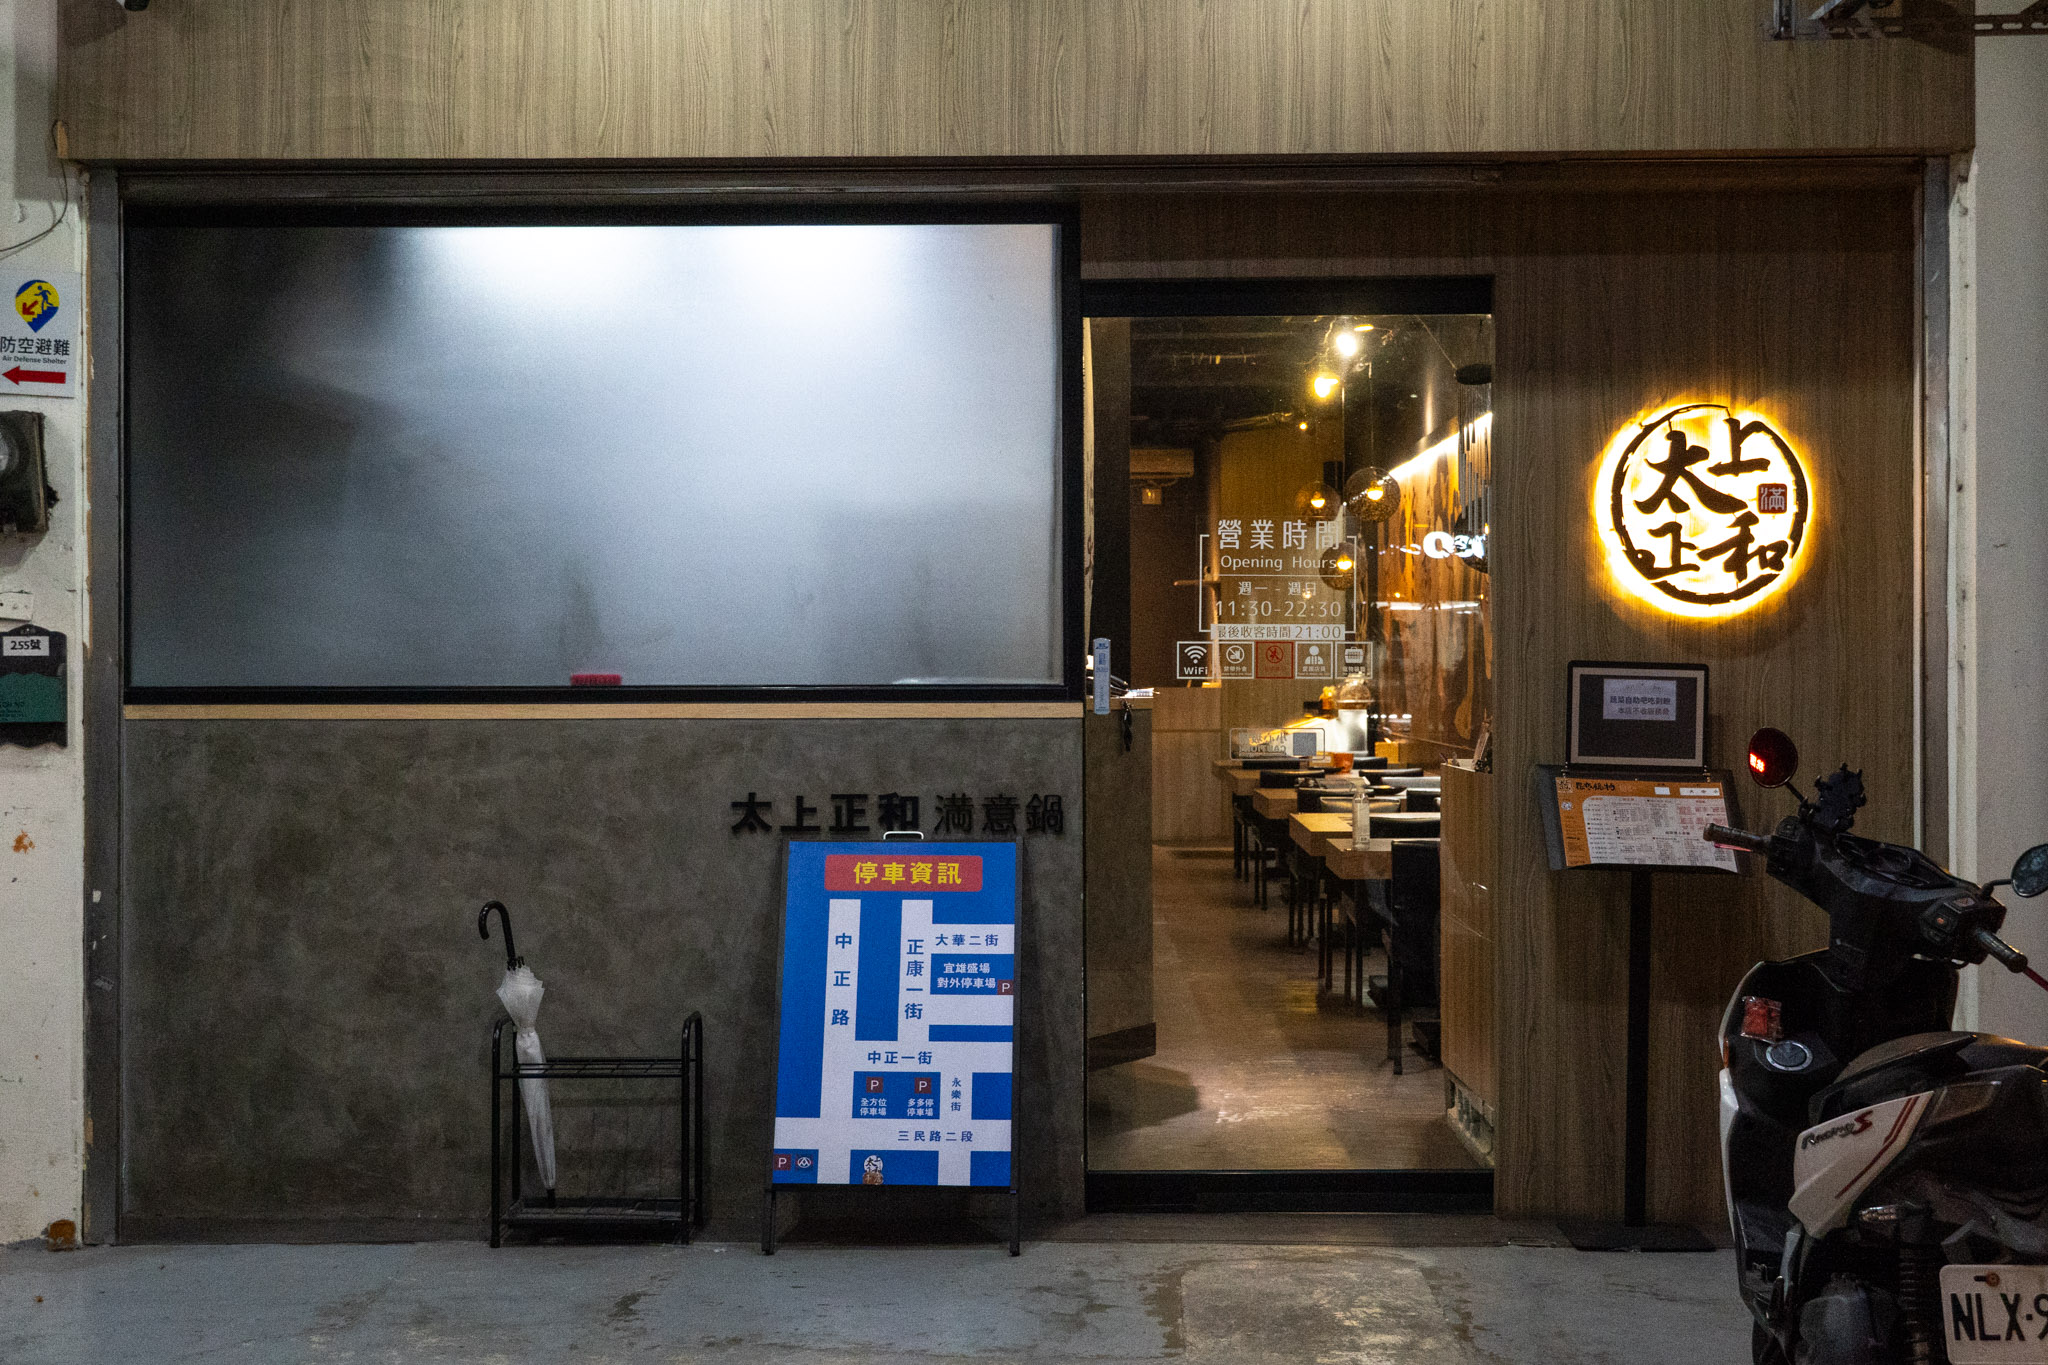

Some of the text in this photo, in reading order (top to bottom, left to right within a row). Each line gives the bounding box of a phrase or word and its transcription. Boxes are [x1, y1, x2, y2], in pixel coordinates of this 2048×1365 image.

[0, 336, 70, 356] 防空避難
[14, 355, 41, 363] Defense
[1217, 519, 1341, 550] 營業時間
[1220, 555, 1337, 572] Opening Hours
[1238, 581, 1269, 596] 週一
[1287, 581, 1317, 596] 週日
[1216, 600, 1342, 617] 11:30-22:30
[1217, 625, 1342, 639] 最後收客時間 21:00
[10, 639, 41, 651] 255號
[1184, 666, 1208, 675] WiFi
[730, 792, 920, 834] 太上正和
[852, 861, 963, 885] 停車資訊
[935, 934, 999, 947] 大華二街
[943, 962, 991, 974] 宜雄盛場
[831, 932, 852, 1026] 中正路
[904, 938, 925, 1020] 正康一街
[936, 977, 997, 989] 對外停車場
[1002, 982, 1011, 993] P
[867, 1050, 933, 1065] 中正一街
[870, 1079, 879, 1091] P
[919, 1080, 928, 1092] P
[951, 1077, 962, 1112] 永樂街
[860, 1097, 888, 1107] 全方位
[907, 1098, 934, 1107] 多多停
[860, 1107, 887, 1116] 停車場
[907, 1108, 934, 1117] 停車場
[897, 1130, 974, 1143] 三民路二段
[778, 1156, 787, 1169] P
